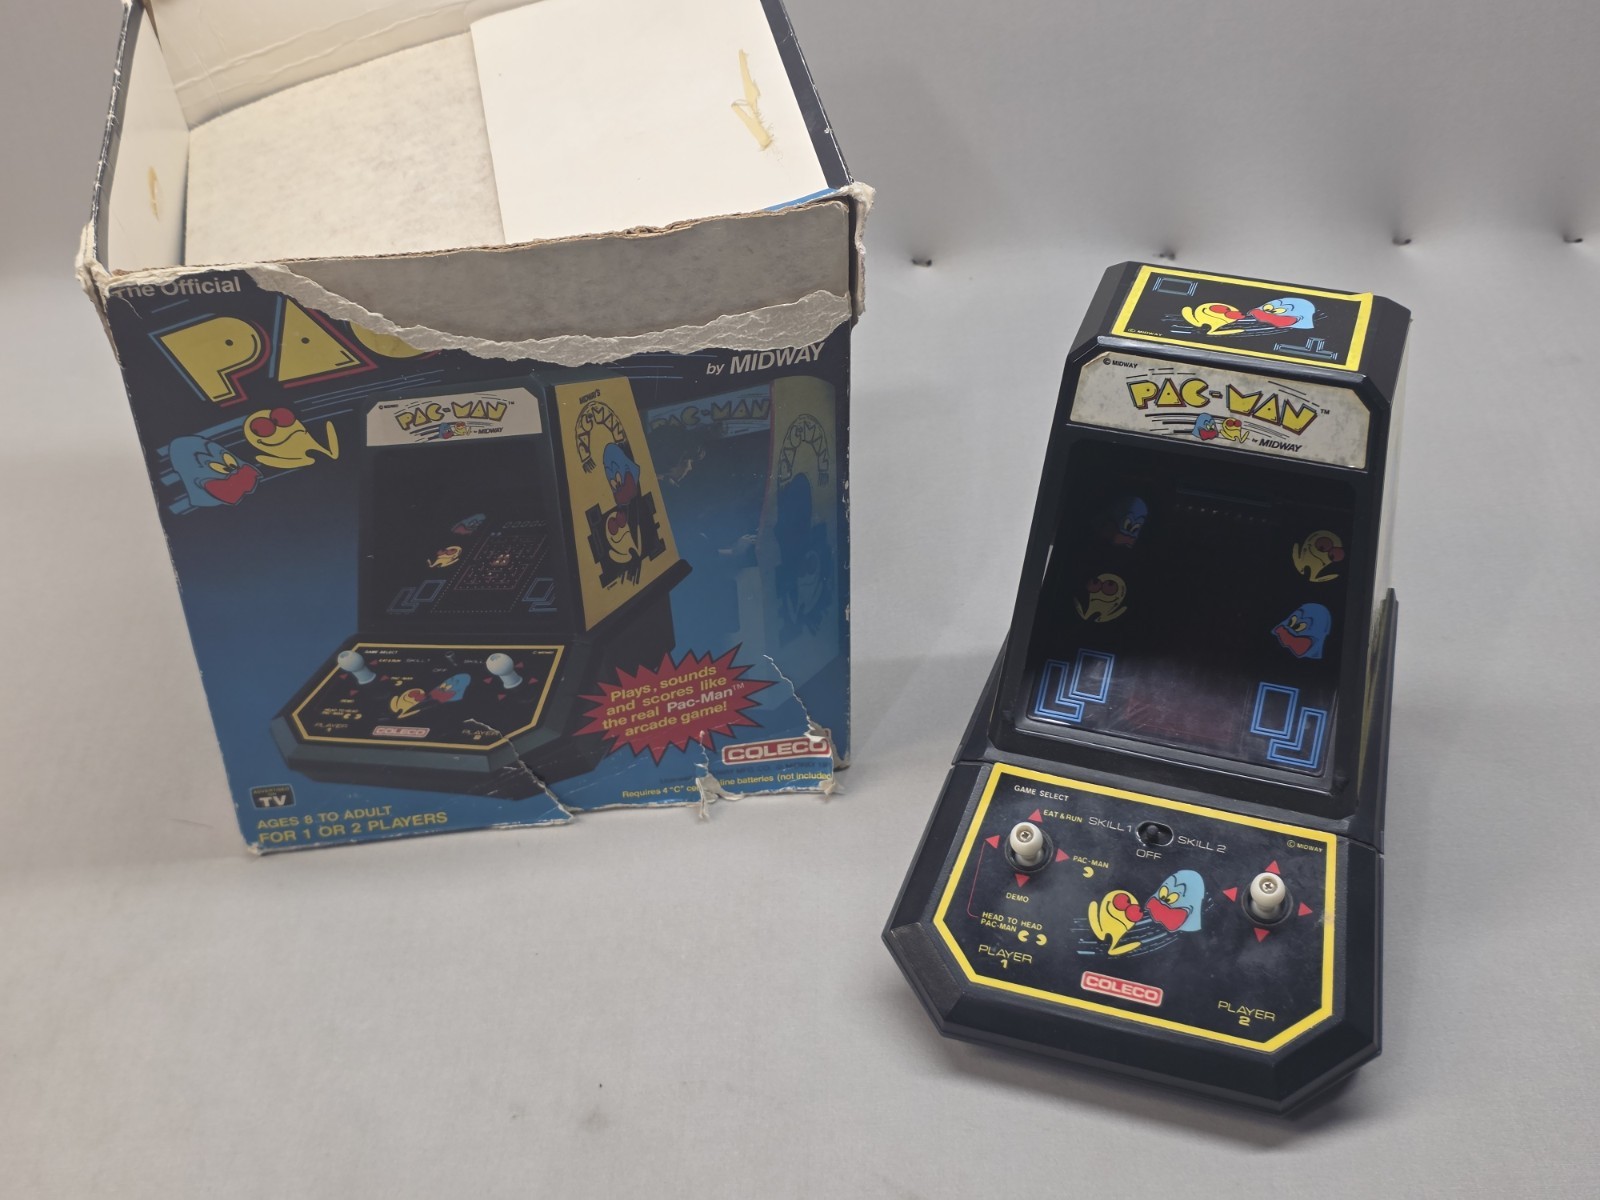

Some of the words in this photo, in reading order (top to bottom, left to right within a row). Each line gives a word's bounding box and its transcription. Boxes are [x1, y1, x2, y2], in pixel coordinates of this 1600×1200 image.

[160, 276, 241, 296] Official
[706, 362, 725, 376] by
[729, 342, 825, 375] MIDWAY
[1112, 360, 1138, 369] MIDWAY
[1258, 438, 1302, 453] MIDWAY
[660, 666, 717, 689] sounds
[606, 700, 636, 716] and
[642, 685, 694, 706] scores
[700, 677, 727, 691] like
[601, 717, 628, 730] the
[631, 706, 660, 723] real
[625, 716, 678, 737] arcade
[681, 701, 727, 724] game!
[376, 727, 425, 736] COLECO
[727, 740, 829, 761] COLECO
[737, 774, 774, 785] batteries
[777, 773, 794, 783] (not
[258, 795, 287, 807] TV
[622, 788, 661, 798] Requires
[1013, 784, 1037, 796] GAME
[1039, 790, 1070, 802] SELECT
[257, 816, 300, 829] AGES
[304, 814, 313, 824] 8
[318, 811, 340, 822] TO
[343, 805, 393, 818] ADULT
[1088, 816, 1125, 832] SKILL
[1126, 825, 1132, 833] 1
[259, 830, 297, 844] FOR
[303, 829, 310, 839] 1
[319, 825, 346, 837] OR
[351, 822, 362, 833] 2
[368, 812, 448, 831] PLAYERS
[1177, 835, 1214, 851] SKILL
[1216, 844, 1227, 853] 2
[1296, 842, 1323, 853] MIDWAY
[1072, 855, 1110, 869] PAC-MAN
[1136, 848, 1162, 860] OFF
[1005, 892, 1029, 903] DEMO
[980, 918, 1017, 932] PAC-MAN
[982, 911, 1004, 922] HEAD
[1007, 916, 1018, 925] TO
[1021, 920, 1043, 931] HEAD
[978, 944, 1033, 963] PLAYER
[1000, 959, 1008, 969] 1
[1085, 975, 1159, 1002] COLECO
[1217, 1000, 1276, 1022] PLAYER
[1238, 1015, 1251, 1027] 2
